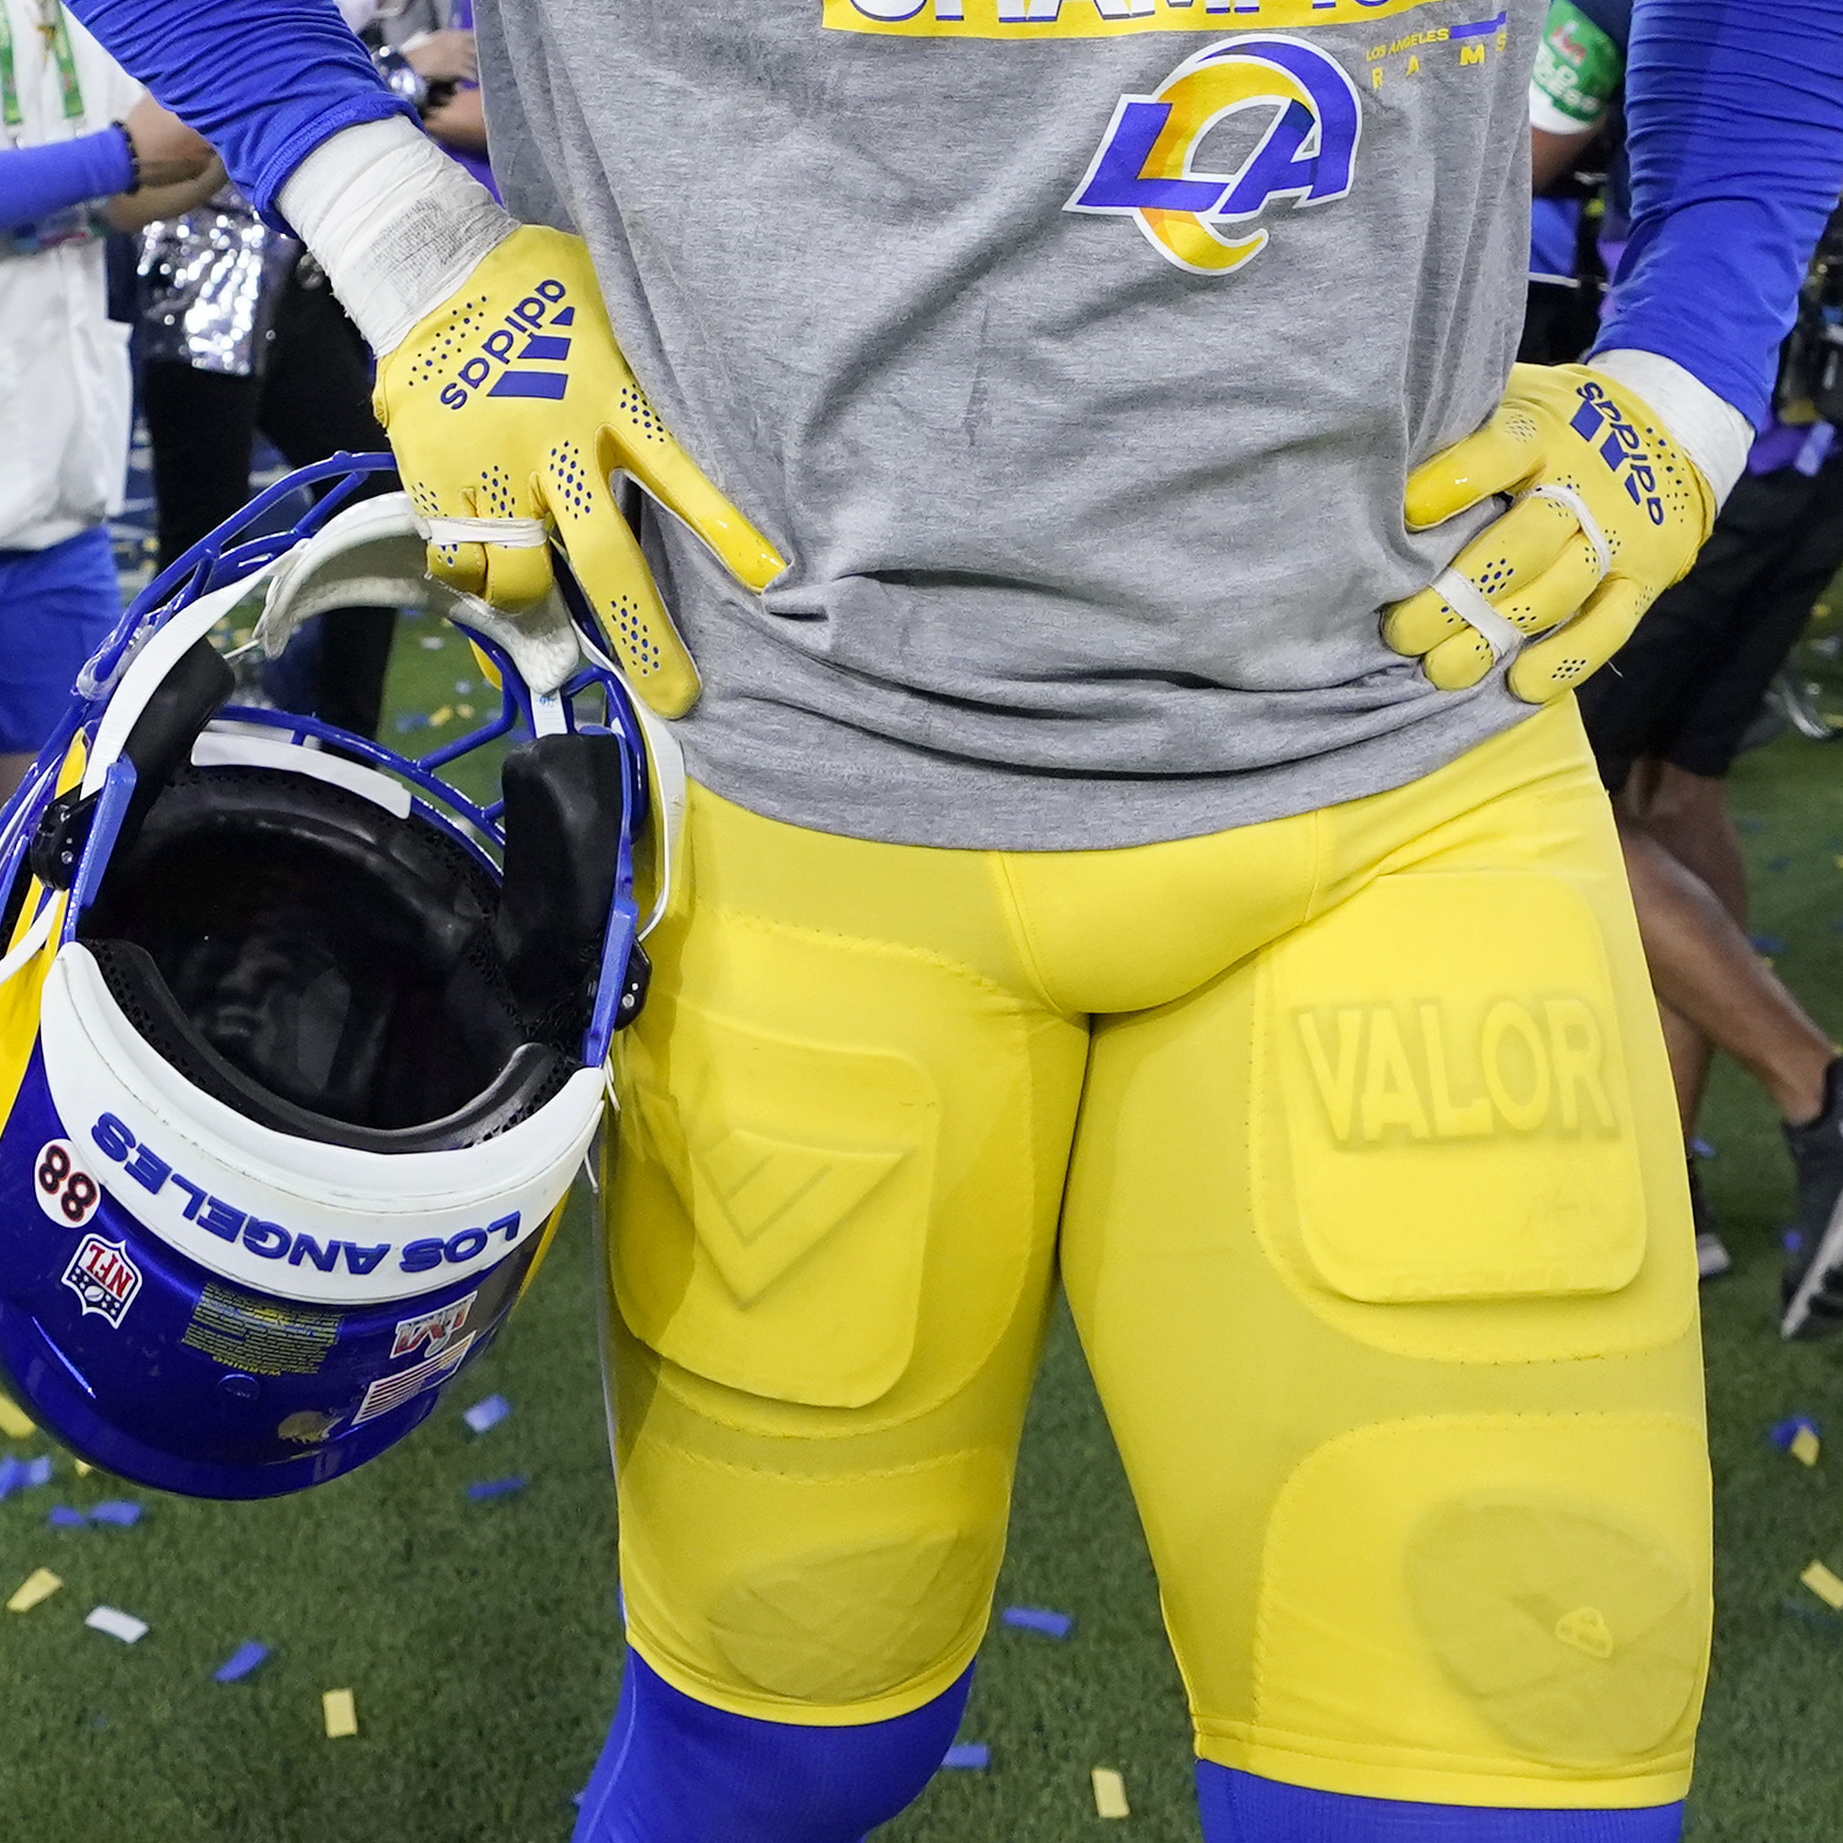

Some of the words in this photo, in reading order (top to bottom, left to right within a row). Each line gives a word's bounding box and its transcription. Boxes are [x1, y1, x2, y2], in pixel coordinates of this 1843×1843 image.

[1365, 44, 1387, 62] LOS
[1389, 27, 1450, 57] ANGELES
[1064, 34, 1362, 242] LA
[439, 278, 567, 411] adidas
[1575, 381, 1665, 526] adidas
[1290, 990, 1621, 1151] VALOR
[38, 1143, 99, 1223] 88
[90, 1111, 392, 1276] ANGELES
[398, 1210, 523, 1273] LOS
[86, 1241, 134, 1299] NFL
